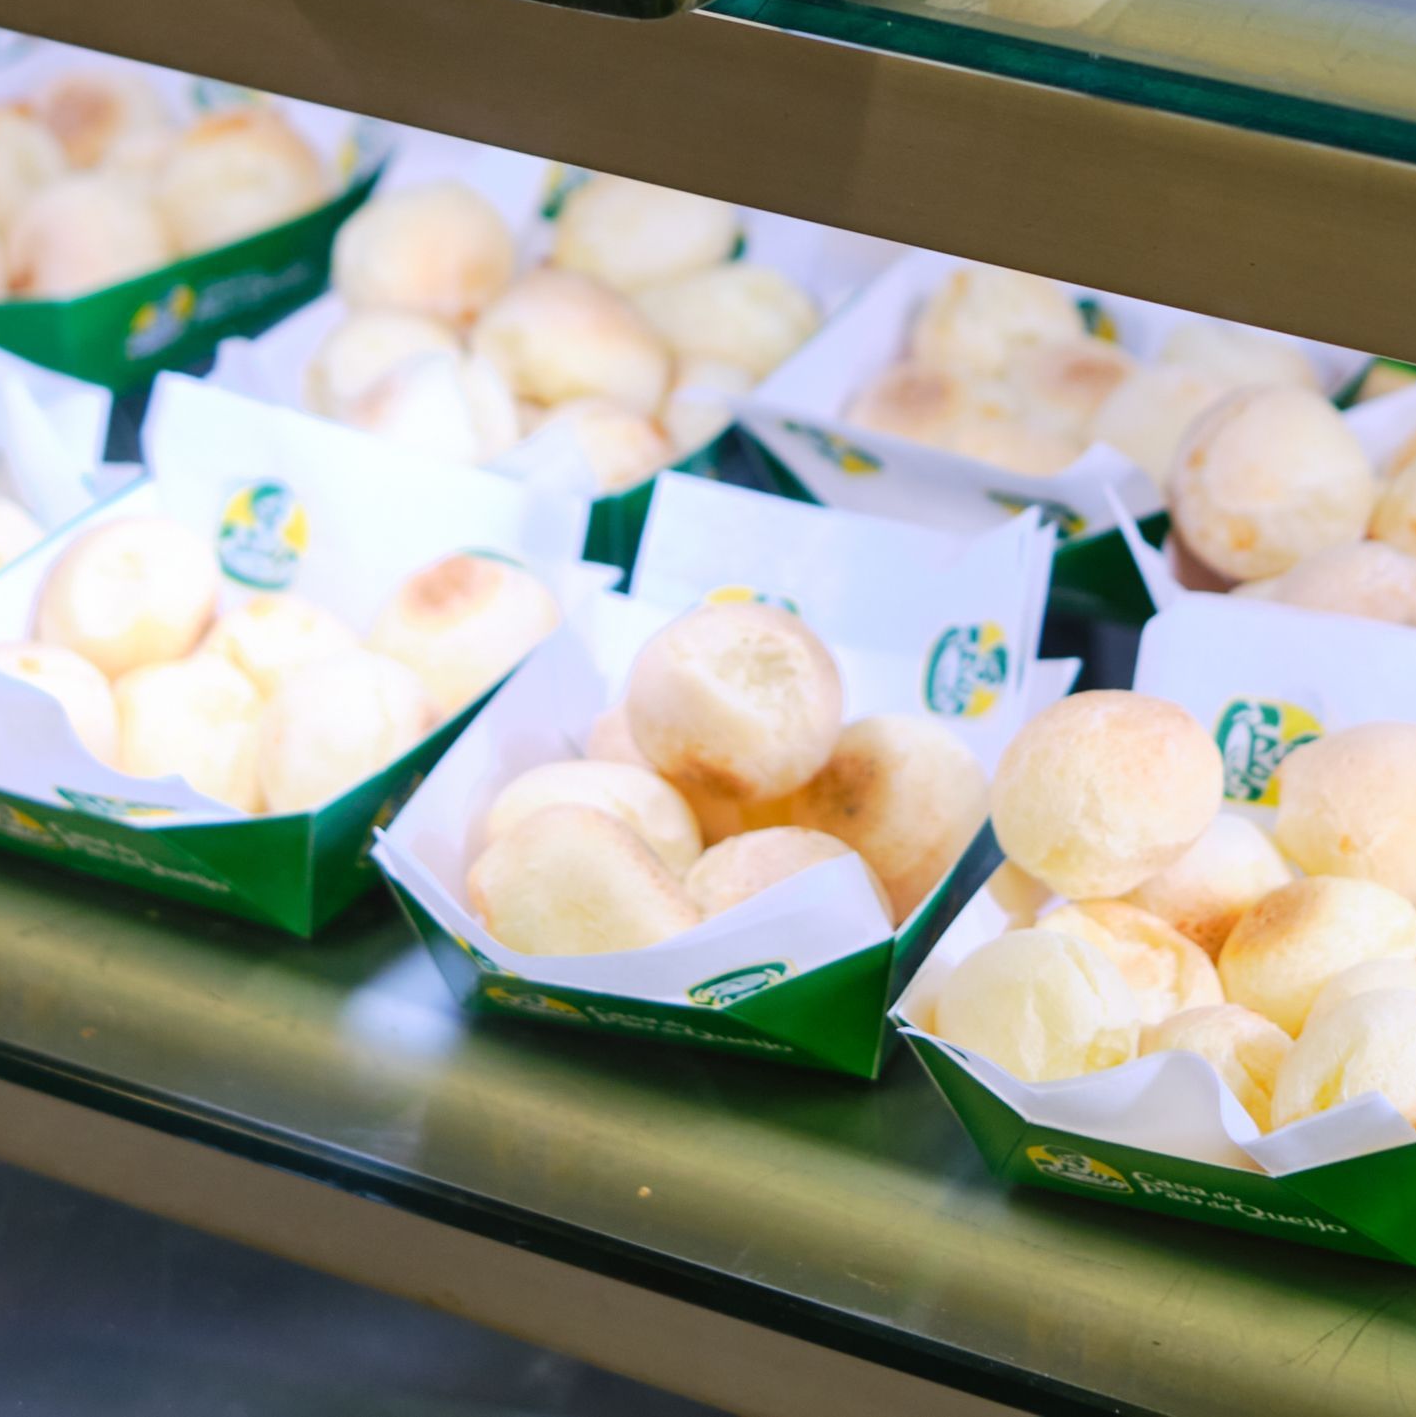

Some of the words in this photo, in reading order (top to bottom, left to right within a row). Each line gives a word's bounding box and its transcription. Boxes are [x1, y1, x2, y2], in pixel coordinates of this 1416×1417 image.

[1132, 1172, 1208, 1197] Casa
[1212, 1192, 1241, 1204] do
[1233, 1203, 1348, 1234] Queijo
